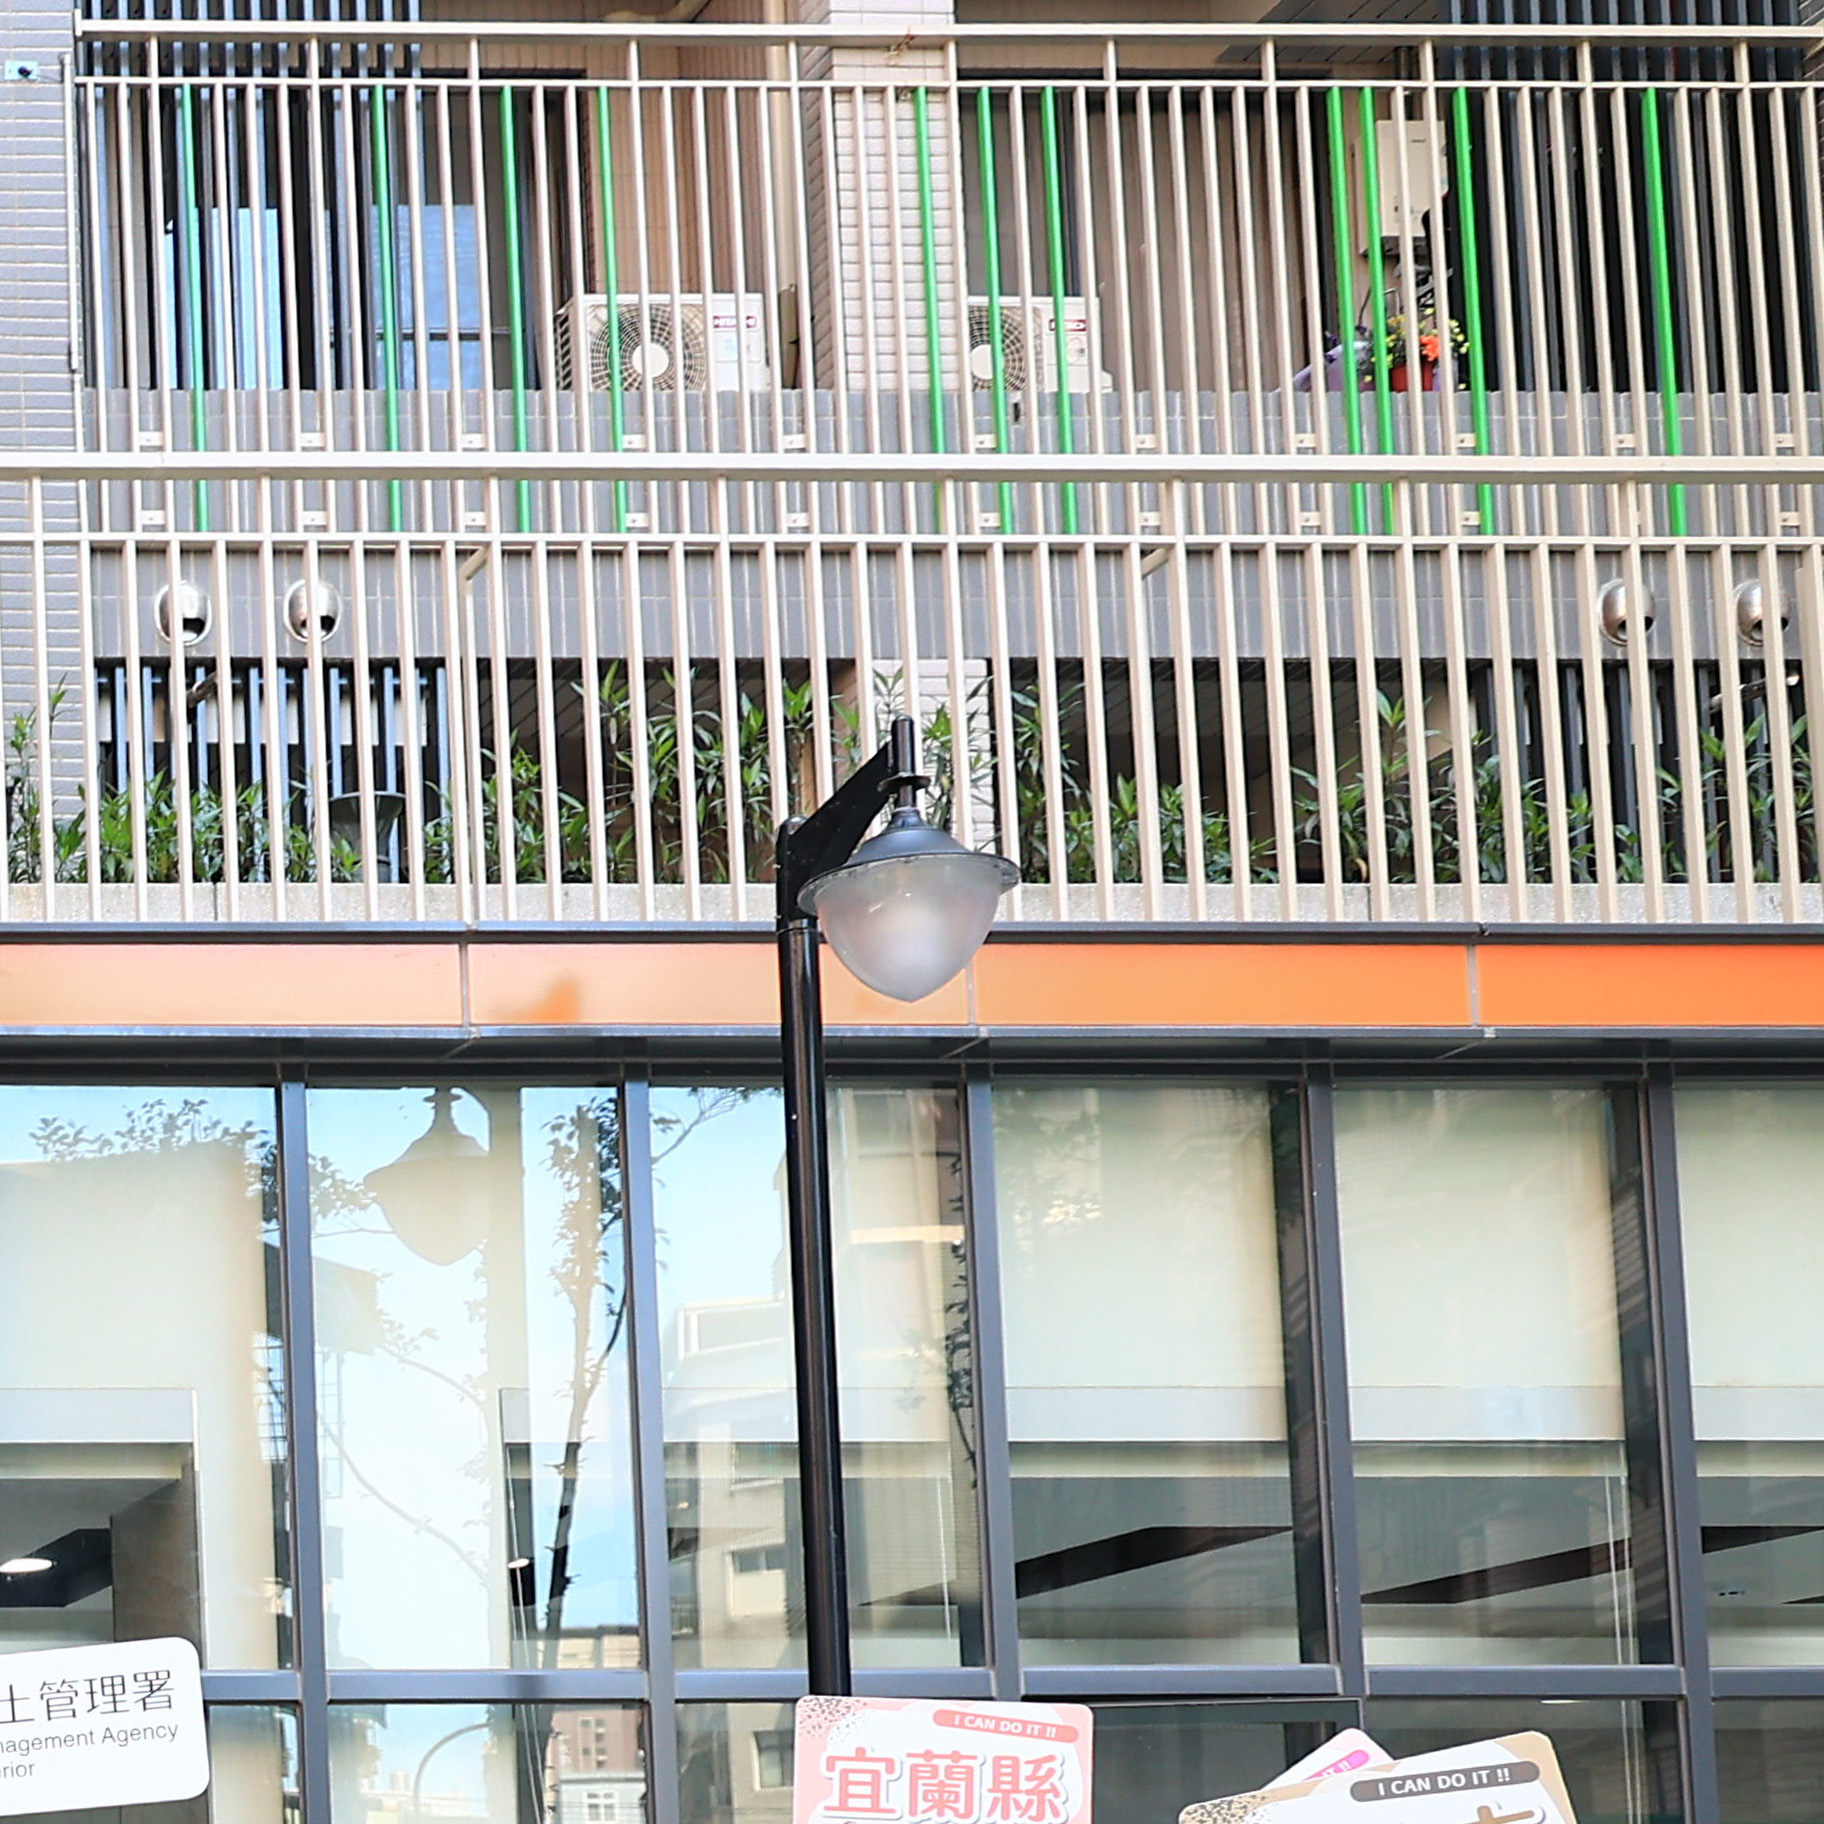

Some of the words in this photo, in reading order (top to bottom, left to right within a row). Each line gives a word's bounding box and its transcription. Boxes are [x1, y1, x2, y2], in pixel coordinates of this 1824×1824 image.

[101, 1721, 179, 1751] Agency
[954, 1715, 959, 1726] I
[964, 1716, 995, 1730] CAN
[1000, 1720, 1022, 1733] DO
[1026, 1723, 1041, 1736] IT
[1045, 1726, 1056, 1738] !!
[823, 1747, 1061, 1822] 宜蘭縣
[1378, 1782, 1385, 1796] I
[1391, 1778, 1431, 1795] CAN
[1437, 1774, 1466, 1788] DO
[1472, 1770, 1491, 1785] IT
[1497, 1768, 1511, 1782] !!
